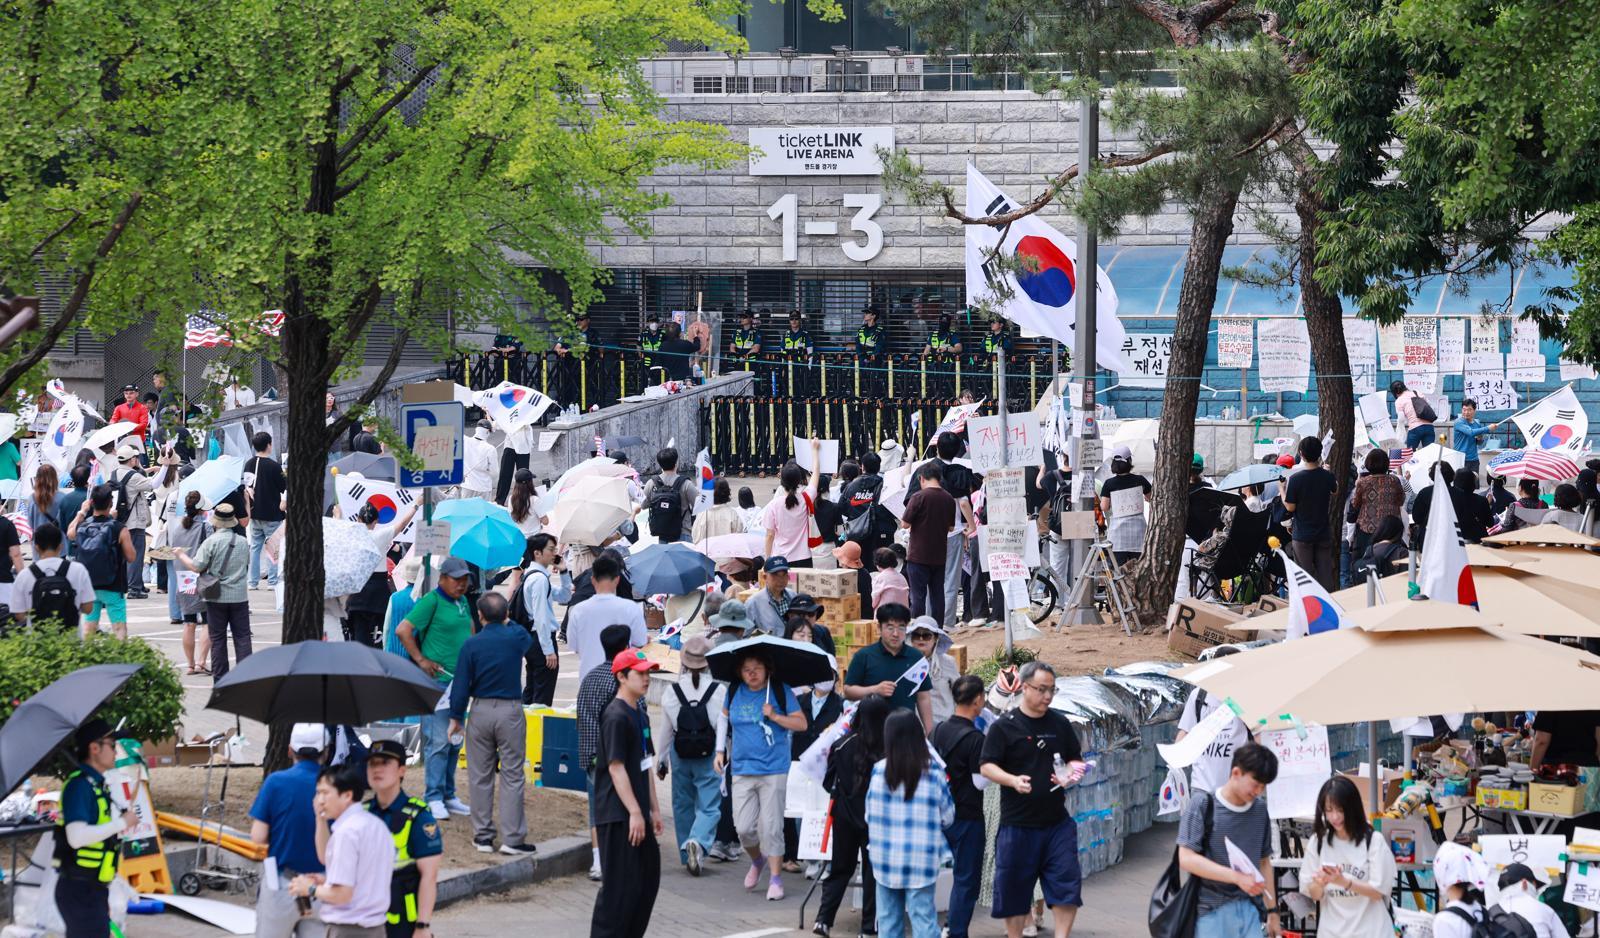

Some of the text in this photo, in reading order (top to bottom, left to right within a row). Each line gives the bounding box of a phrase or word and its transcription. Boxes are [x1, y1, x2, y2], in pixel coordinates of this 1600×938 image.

[778, 133, 863, 148] ticketLINK
[787, 149, 854, 159] LIVE ARENA
[767, 193, 884, 262] 1-3
[1134, 358, 1164, 376] 재선
[1466, 380, 1503, 395] 부정선
[855, 490, 874, 500] nike
[1176, 604, 1196, 631] R
